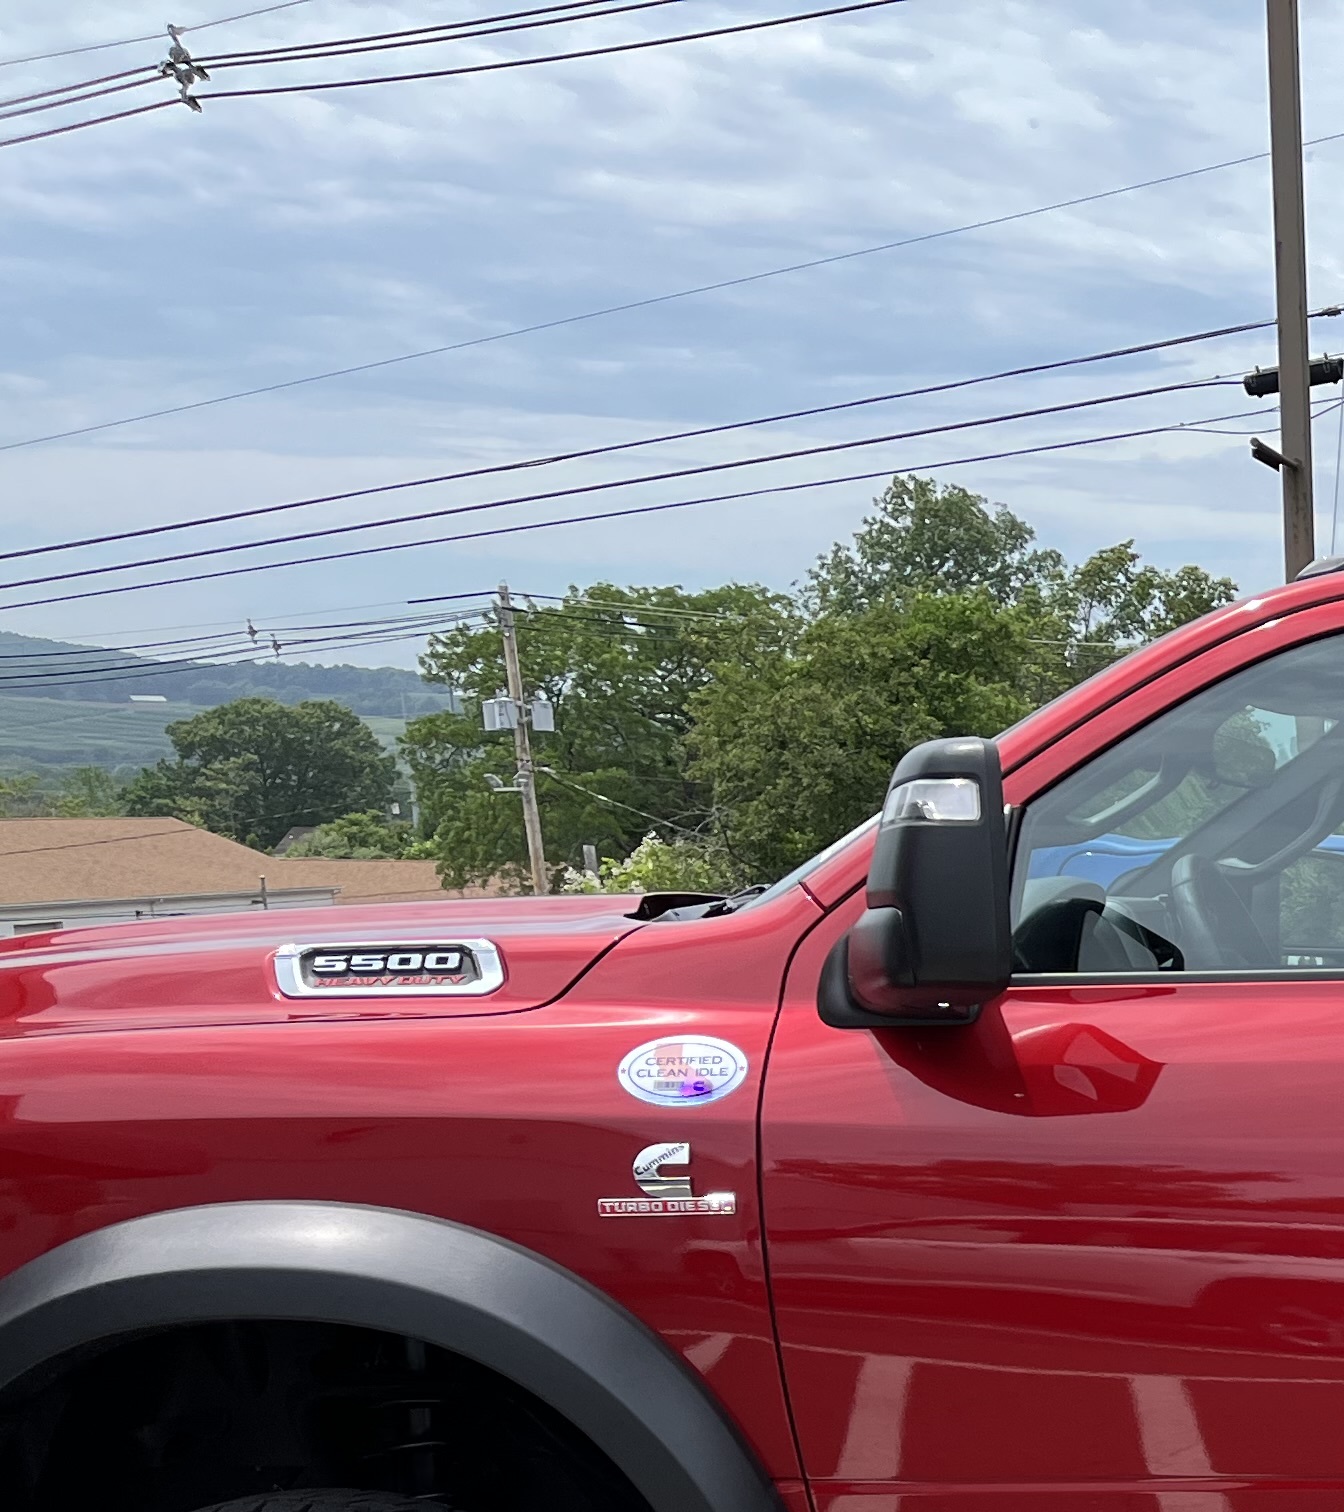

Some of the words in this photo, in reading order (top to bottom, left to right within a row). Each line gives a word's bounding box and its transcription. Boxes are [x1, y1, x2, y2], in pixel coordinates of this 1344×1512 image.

[312, 952, 461, 972] 5500
[314, 975, 391, 988] HEAVY
[397, 974, 466, 986] DUTY
[645, 1055, 723, 1066] CERTIFIED
[636, 1068, 689, 1078] CLEAN
[695, 1067, 729, 1077] IDLE
[634, 1144, 685, 1176] Cummins
[602, 1201, 664, 1213] TURBO
[666, 1200, 735, 1213] DIESE
